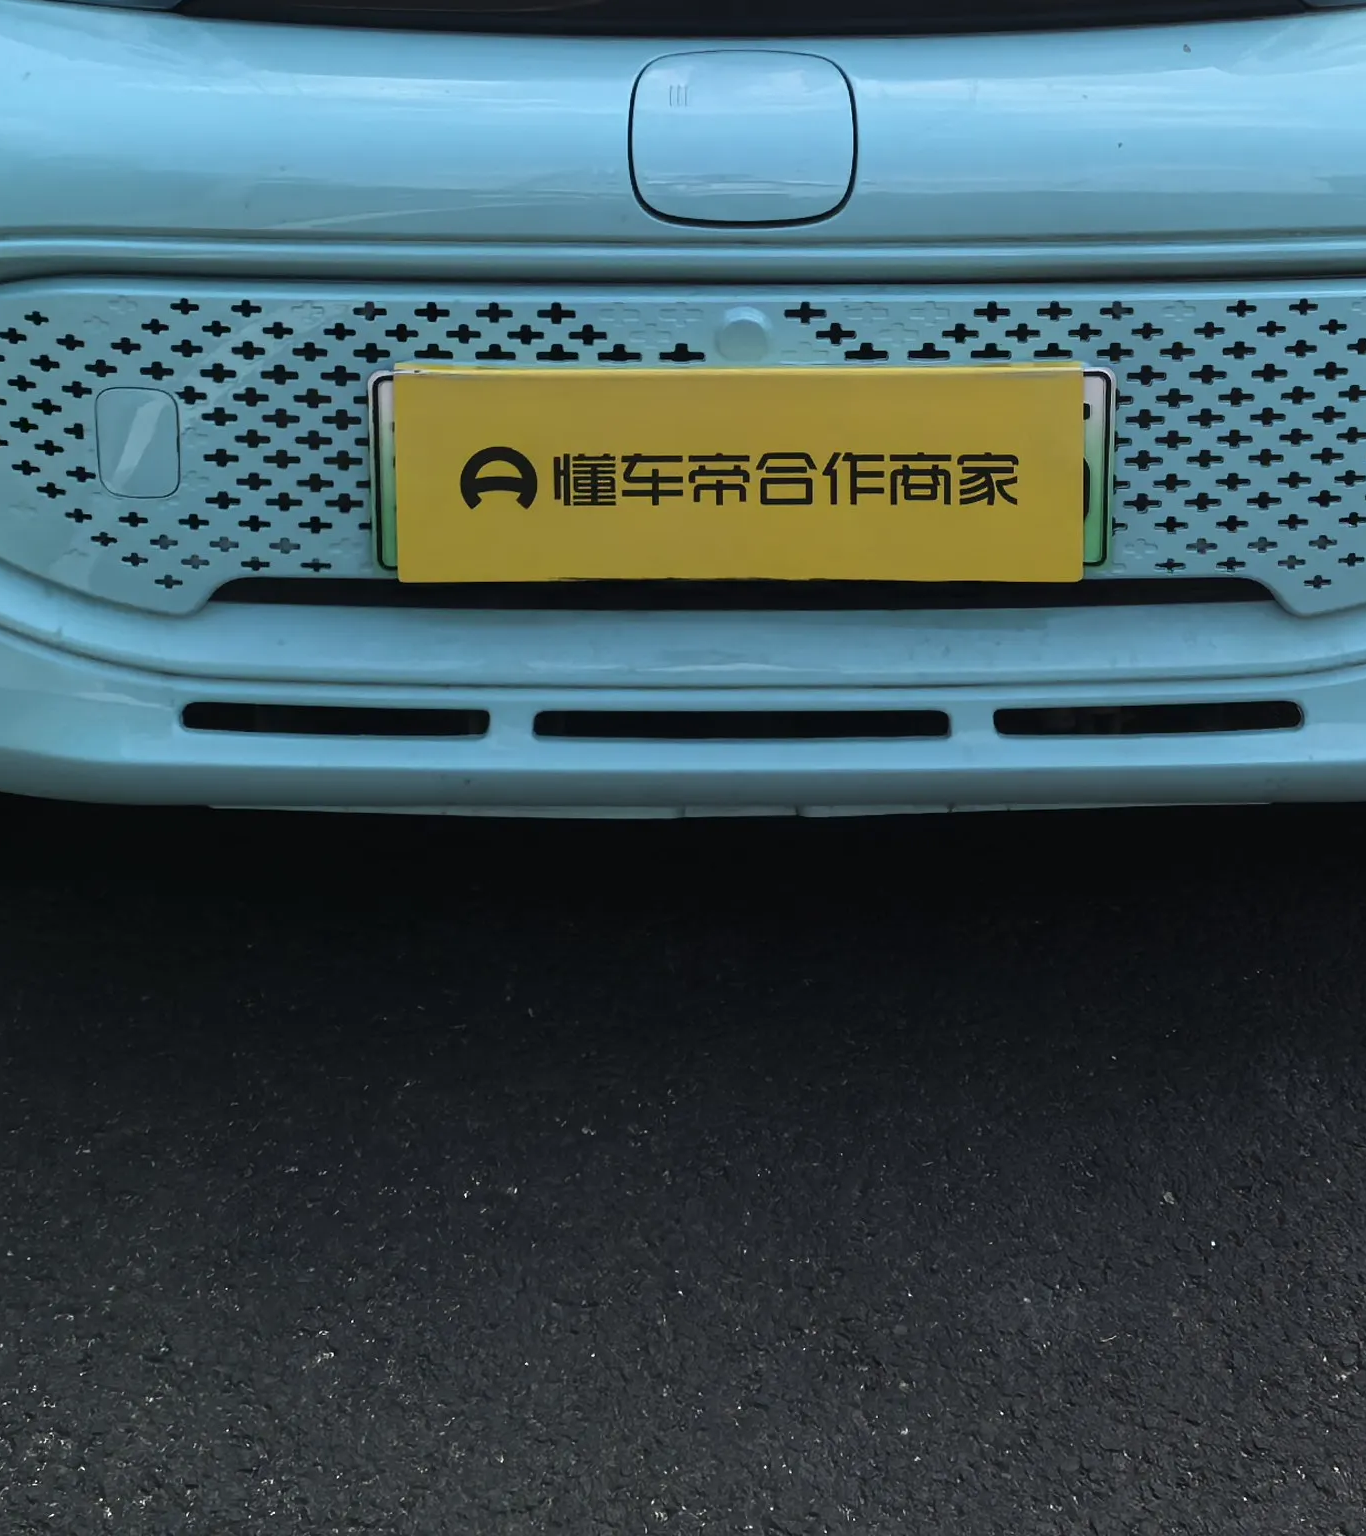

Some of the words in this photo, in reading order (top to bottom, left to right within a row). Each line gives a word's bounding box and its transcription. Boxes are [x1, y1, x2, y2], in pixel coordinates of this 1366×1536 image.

[552, 450, 1020, 507] 懂车帝合作商家
